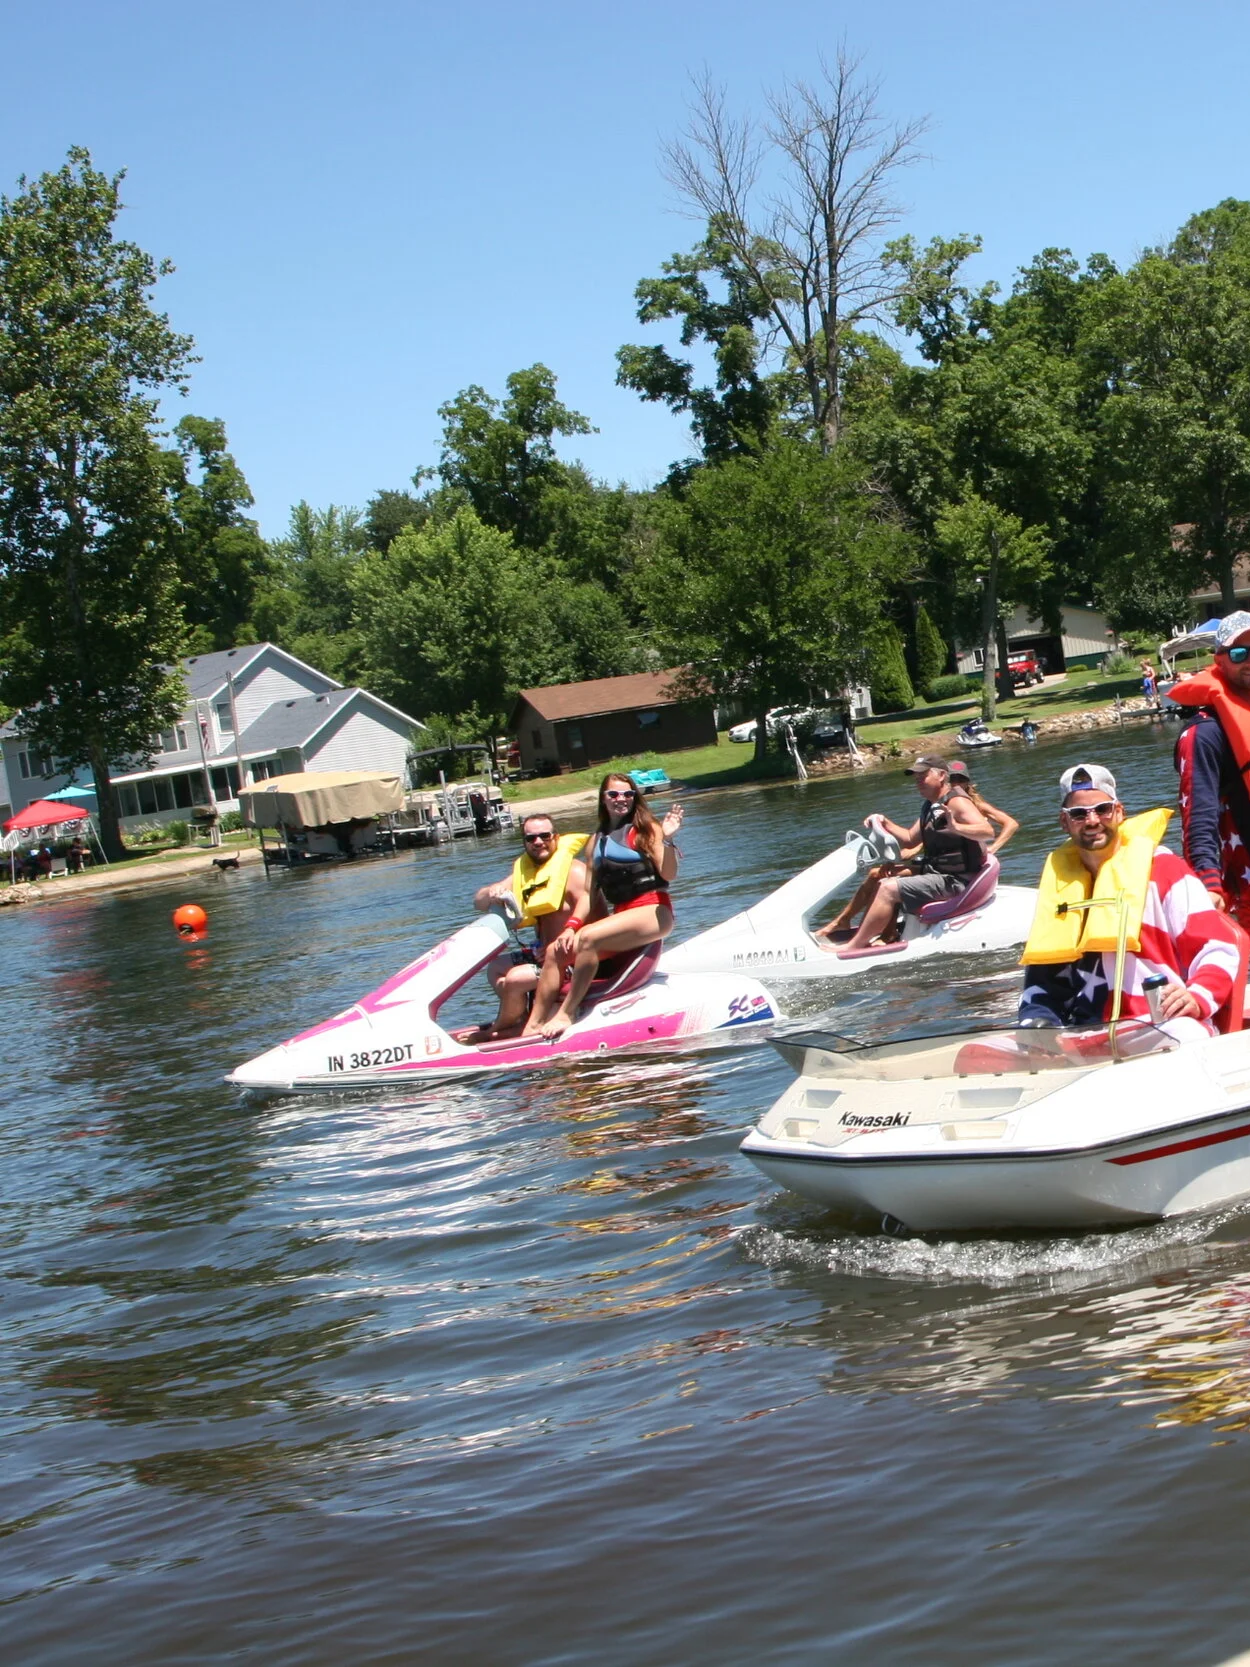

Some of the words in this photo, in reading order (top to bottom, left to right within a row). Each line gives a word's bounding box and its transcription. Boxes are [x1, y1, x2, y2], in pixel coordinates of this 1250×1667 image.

[328, 1055, 344, 1072] IN
[350, 1044, 413, 1069] 3822DT
[837, 1111, 912, 1127] Kawasaki
